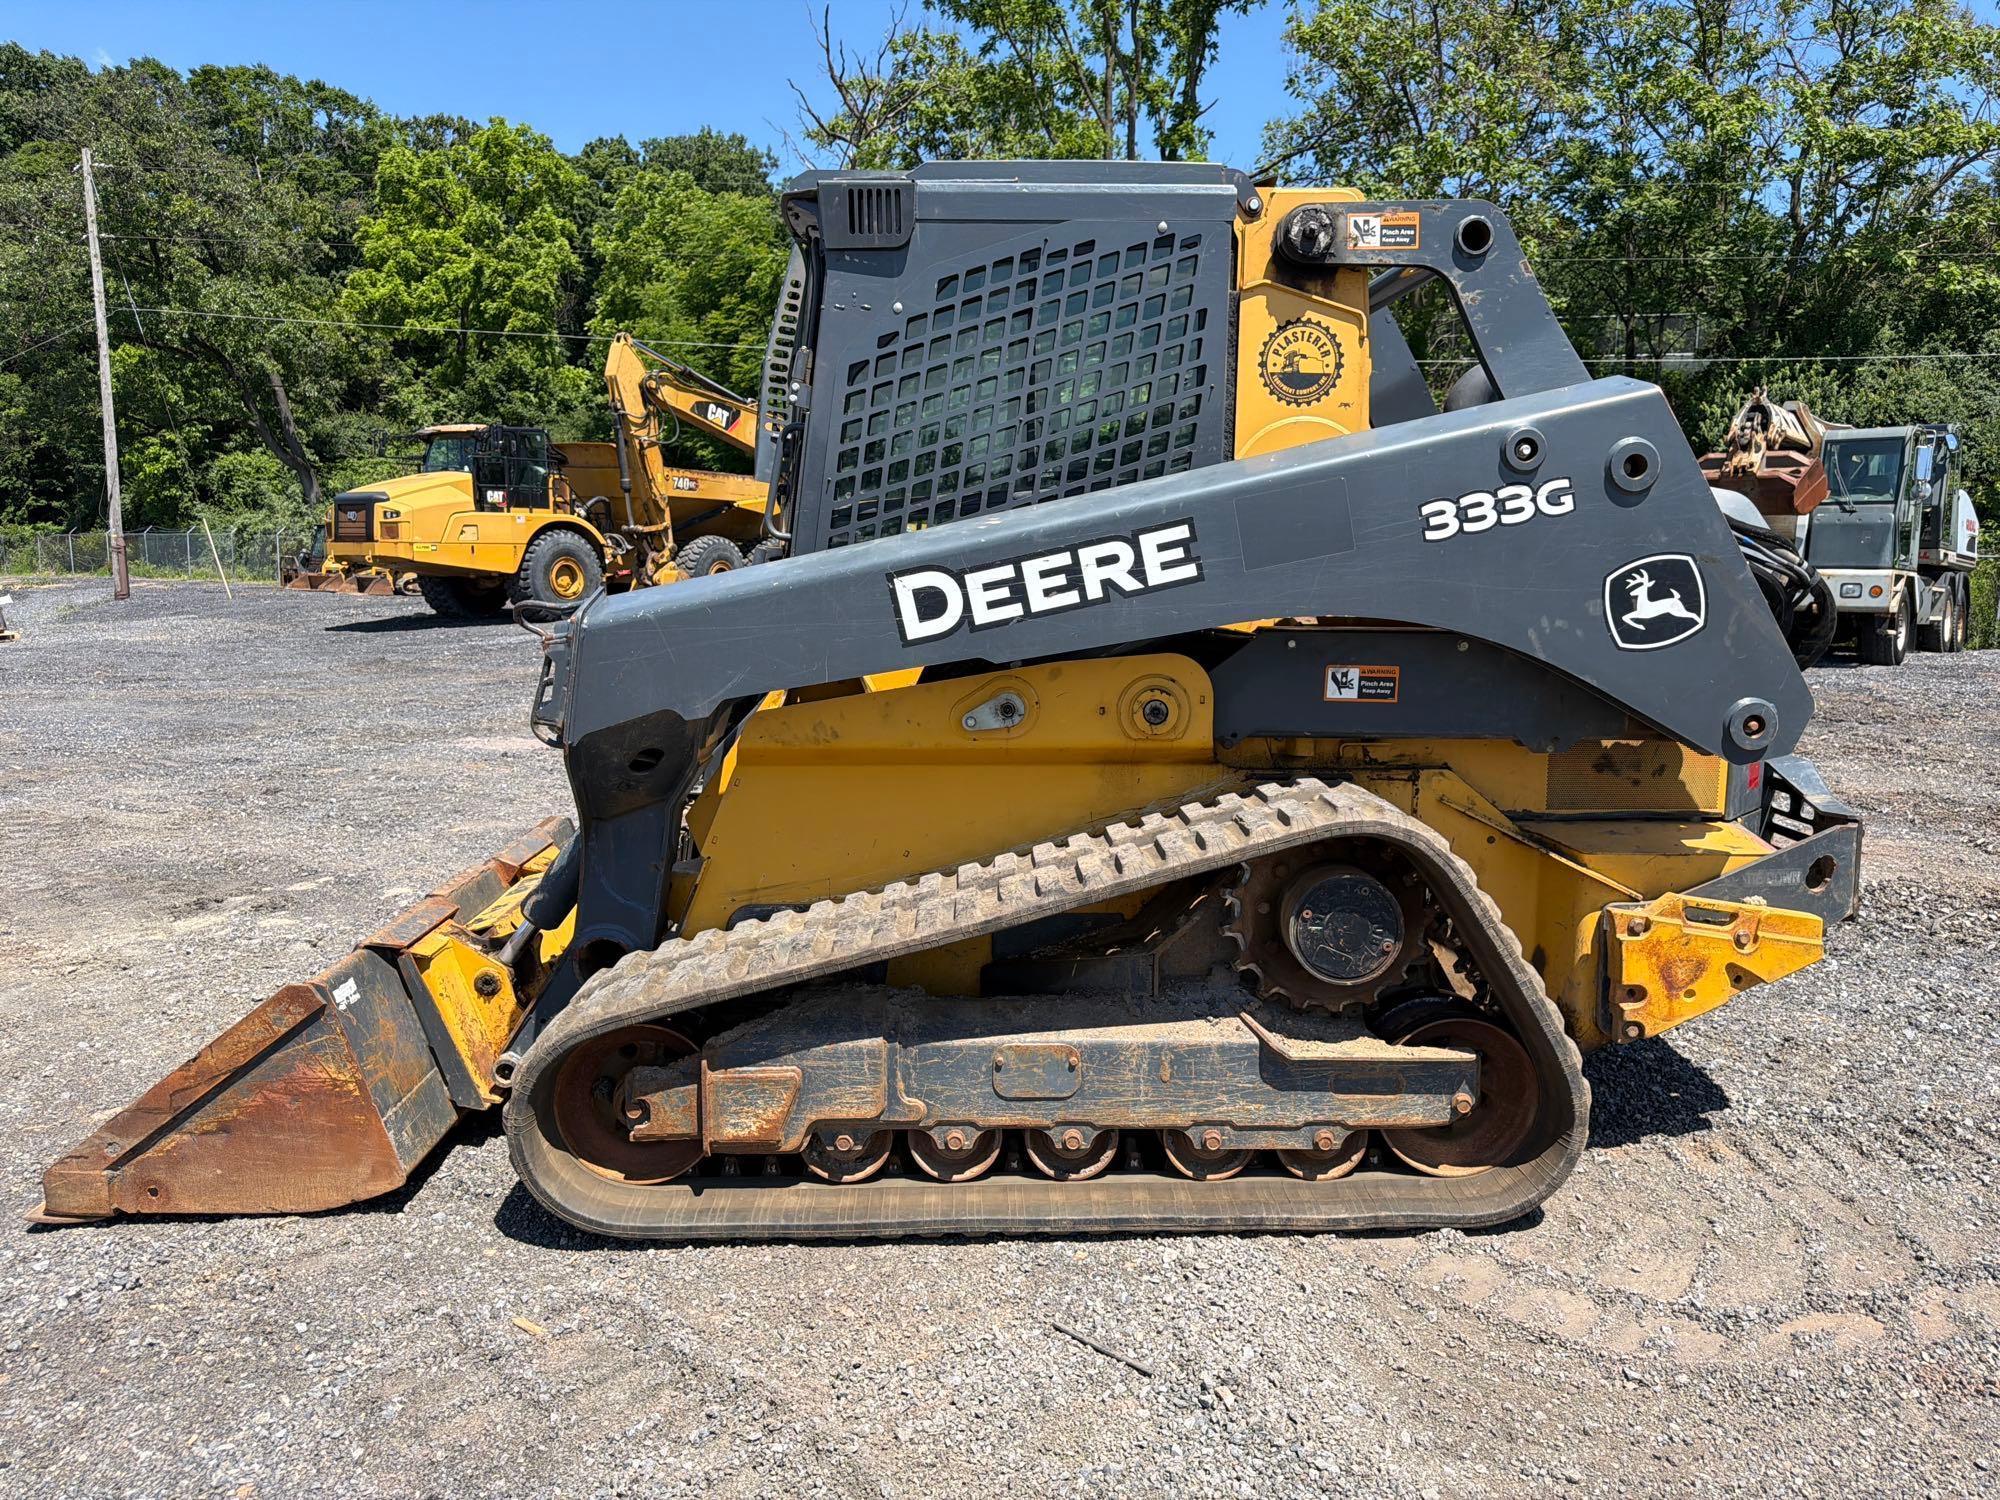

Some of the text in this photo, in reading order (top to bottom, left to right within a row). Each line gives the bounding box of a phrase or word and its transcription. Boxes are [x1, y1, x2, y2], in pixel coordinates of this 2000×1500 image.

[1272, 330, 1331, 358] PLASTERER
[707, 403, 729, 428] CAT
[487, 491, 503, 502] CAT
[1421, 478, 1575, 540] 333G
[893, 524, 1198, 640] DEERE
